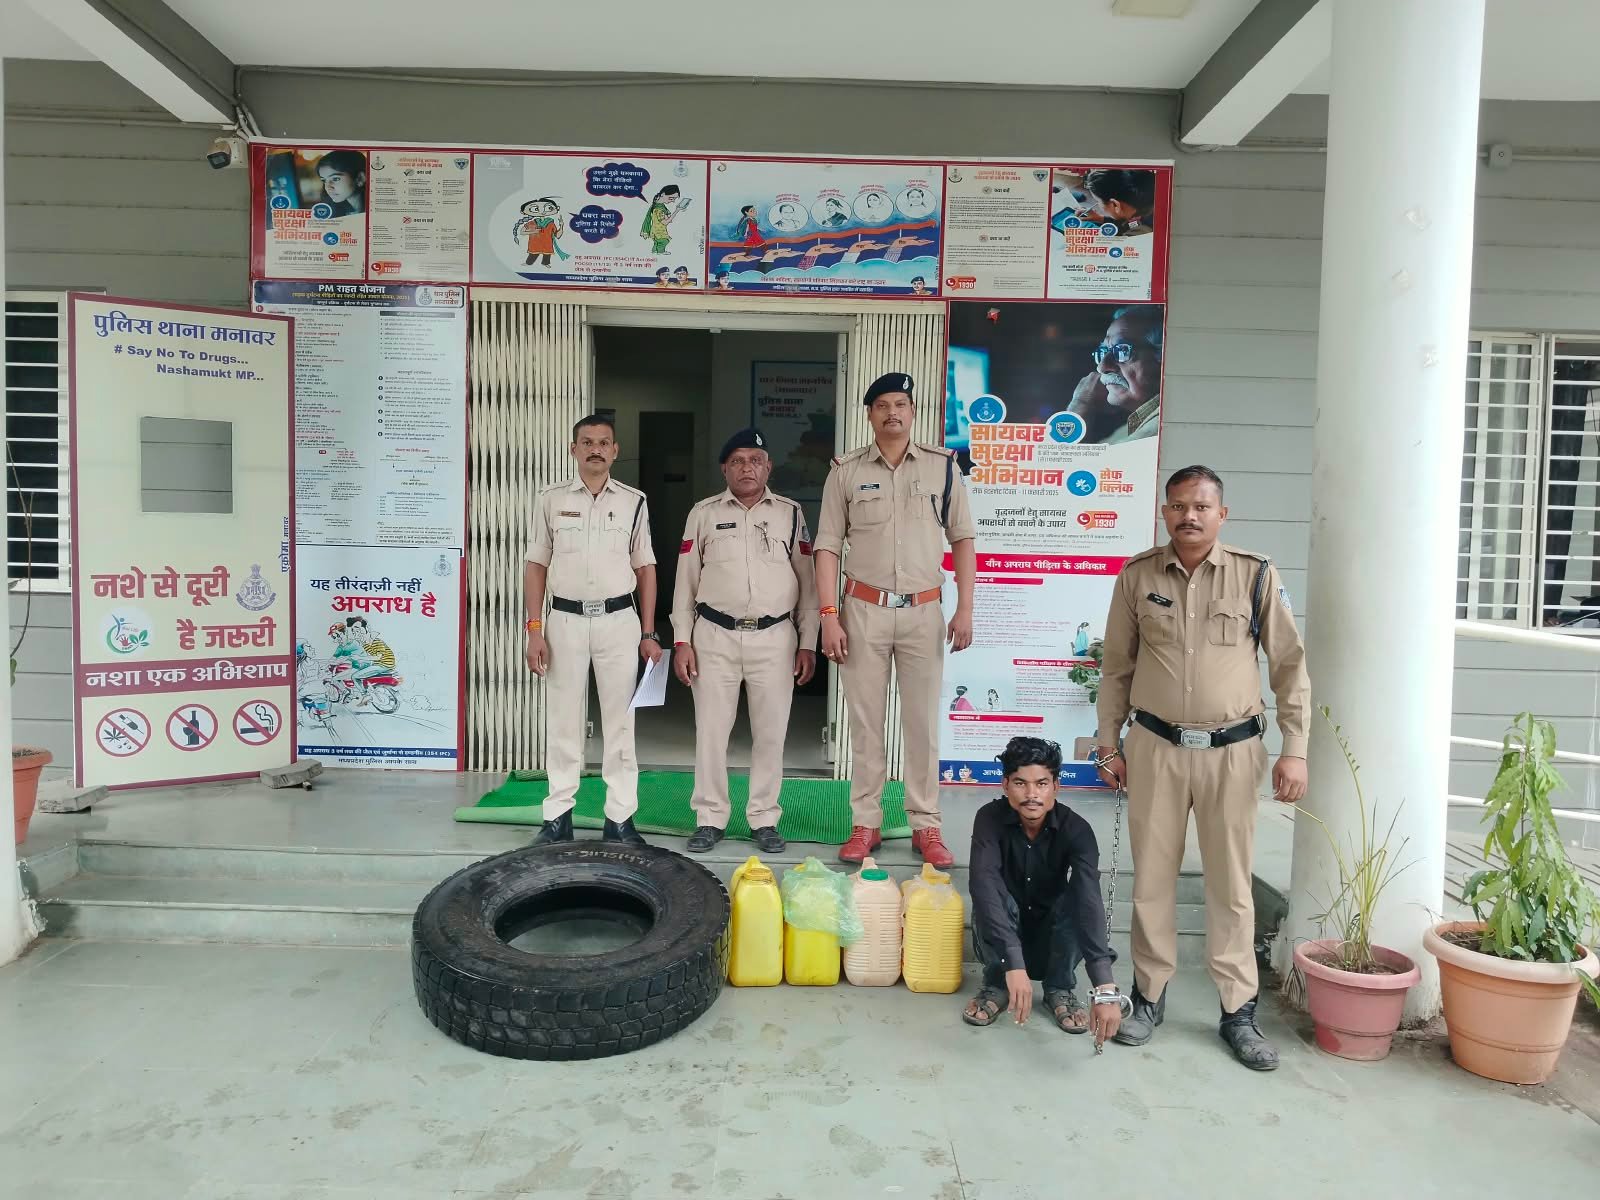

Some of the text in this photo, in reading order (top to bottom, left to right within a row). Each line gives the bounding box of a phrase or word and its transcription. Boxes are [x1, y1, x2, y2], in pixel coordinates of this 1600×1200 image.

[273, 209, 312, 219] सायबर
[273, 219, 305, 230] सुरक्षा
[1065, 228, 1100, 236] सायबर
[1065, 235, 1095, 245] सुरक्षा
[1065, 244, 1109, 254] अभियान
[336, 284, 357, 293] राहत
[359, 285, 386, 294] योजना
[444, 289, 460, 299] पुलिस
[94, 311, 276, 346] पुलिस थाना मनावर
[114, 345, 249, 365] # Say No To Drugs...
[156, 364, 264, 381] Nashamukt MP...
[970, 424, 1046, 442] सायबर
[971, 444, 1035, 466] सुरक्षा
[971, 464, 1064, 486] अभियान
[1099, 469, 1123, 480] सेफ
[1099, 481, 1134, 494] क्लिक
[1027, 508, 1038, 519] हेतु
[1039, 509, 1067, 517] सायबर
[977, 517, 1067, 528] अपराधों से बचने के उपाय
[1095, 519, 1114, 527] 1930
[1004, 560, 1031, 570] अपराध
[1033, 560, 1061, 571] पीड़िता
[1062, 560, 1072, 570] के
[1074, 561, 1107, 571] अधिकार
[90, 565, 231, 606] नशे से दूरी
[310, 576, 422, 593] यह तीरंदाज़ी नहीं
[331, 592, 436, 618] अपराध है
[176, 618, 197, 650] है
[85, 660, 288, 687] नशा एक अभिशाप
[365, 757, 383, 765] पुलिस
[982, 769, 1003, 777] आपके
